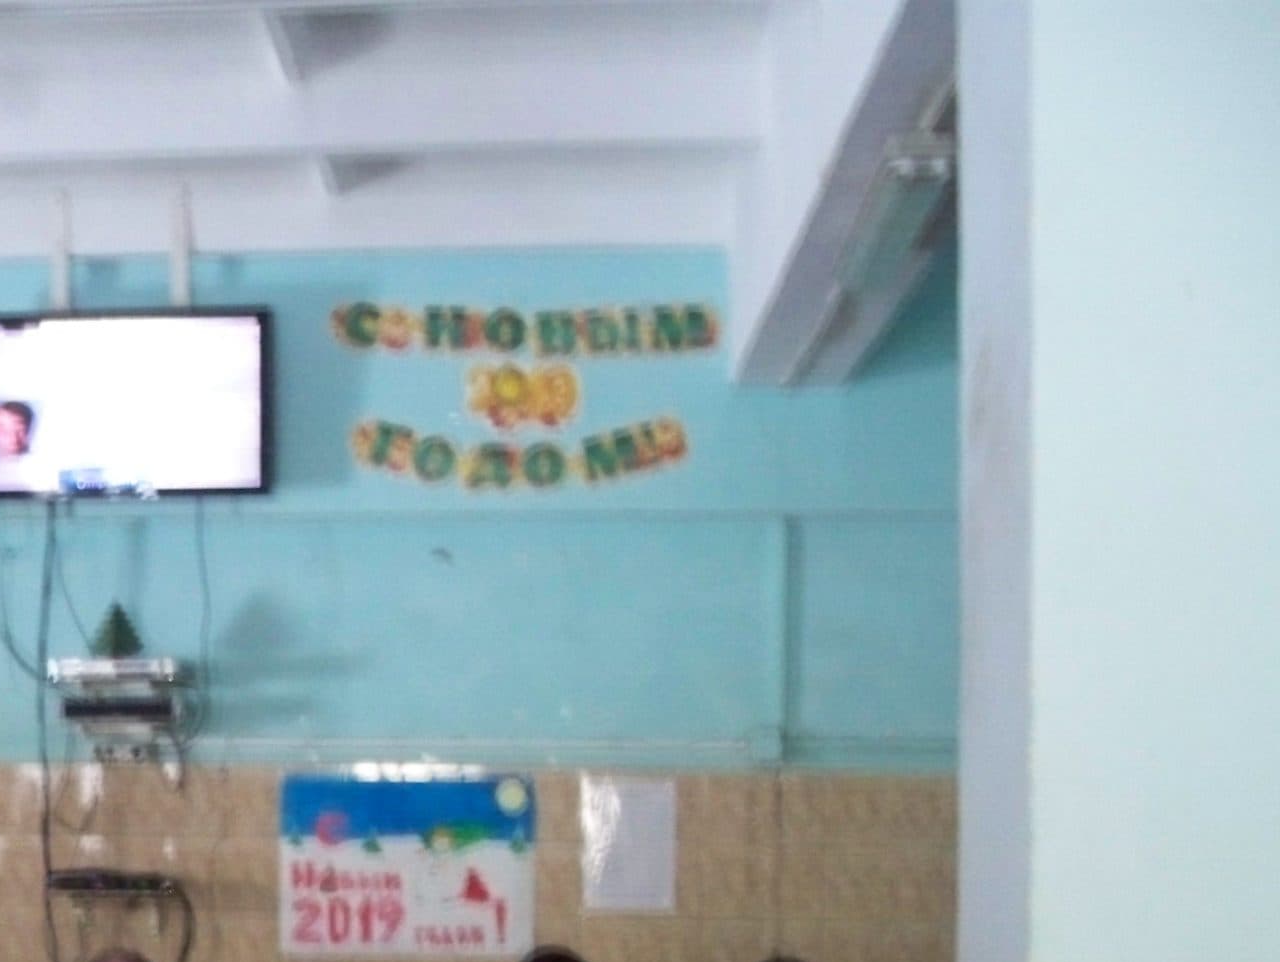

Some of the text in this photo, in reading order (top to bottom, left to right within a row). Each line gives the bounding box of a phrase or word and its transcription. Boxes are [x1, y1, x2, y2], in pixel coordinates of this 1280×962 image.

[343, 301, 711, 355] С НОВЫМ
[292, 897, 406, 943] 2019
